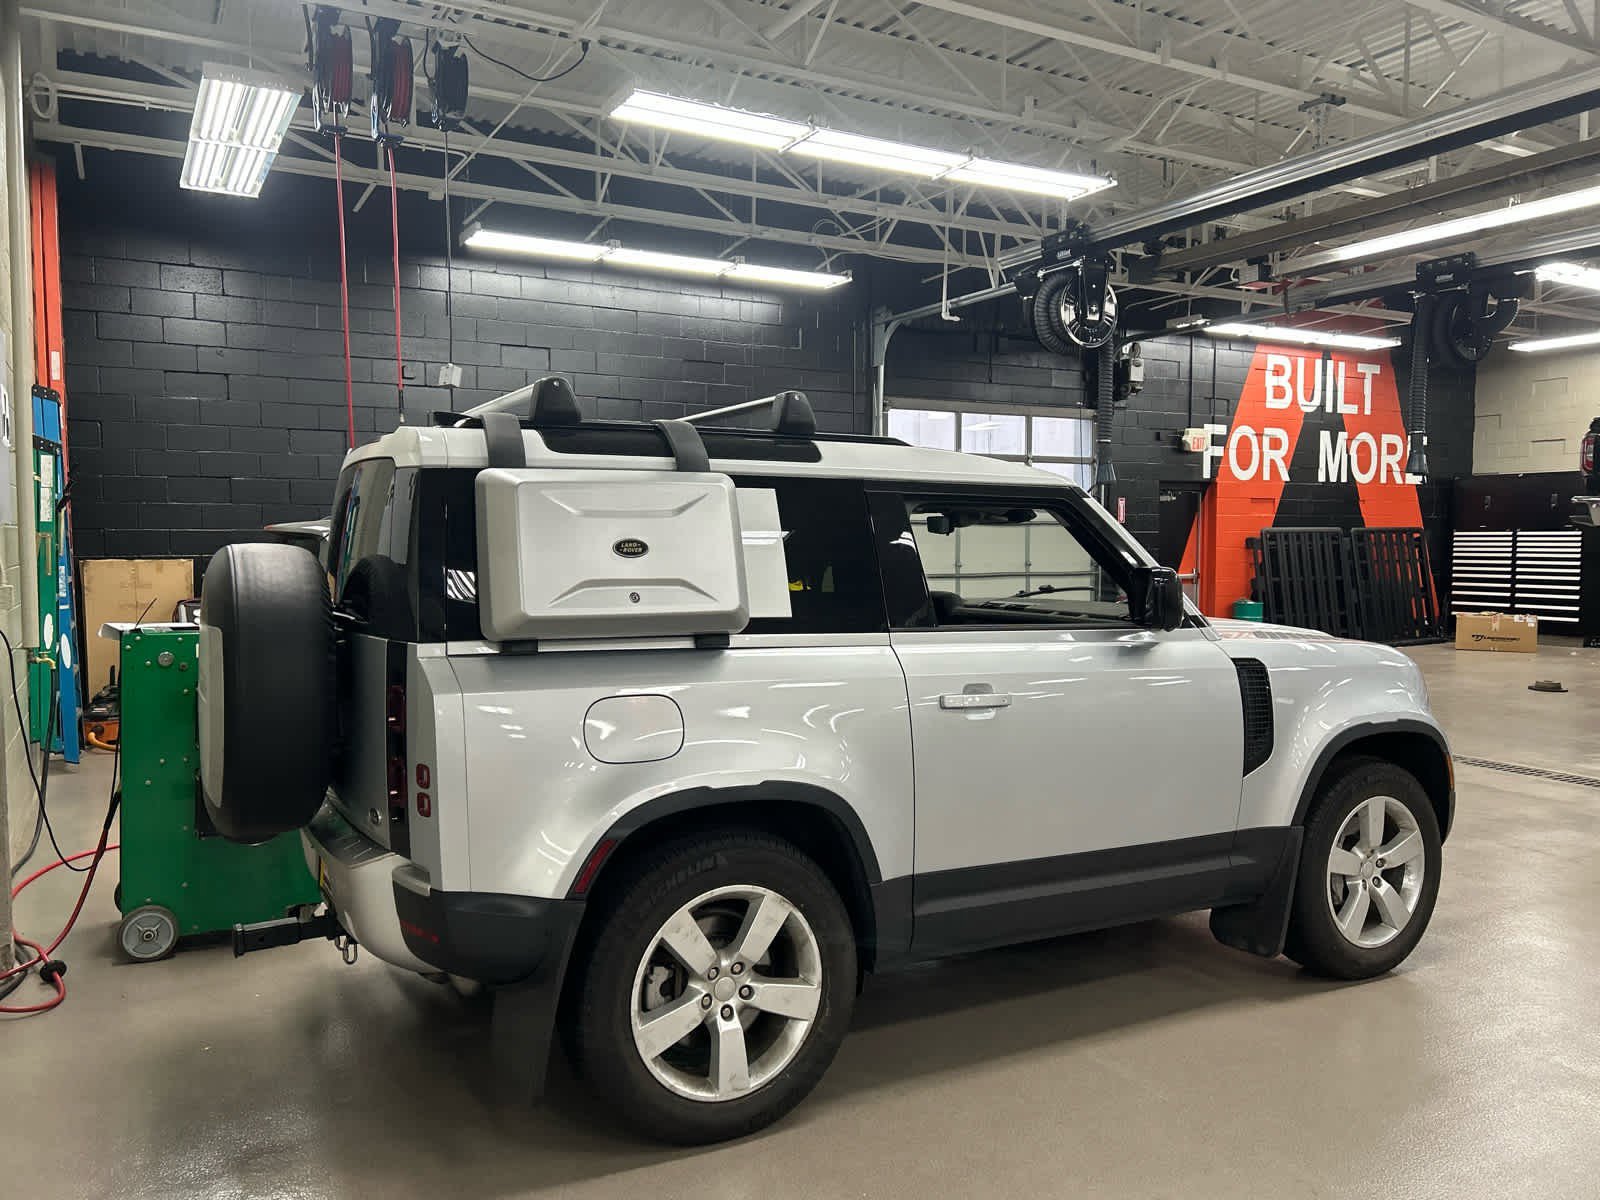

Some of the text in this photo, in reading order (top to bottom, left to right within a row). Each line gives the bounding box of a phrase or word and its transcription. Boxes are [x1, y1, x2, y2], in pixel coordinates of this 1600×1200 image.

[1265, 354, 1381, 415] BUILT
[1191, 437, 1206, 449] EXIT
[1202, 423, 1290, 481] FOR
